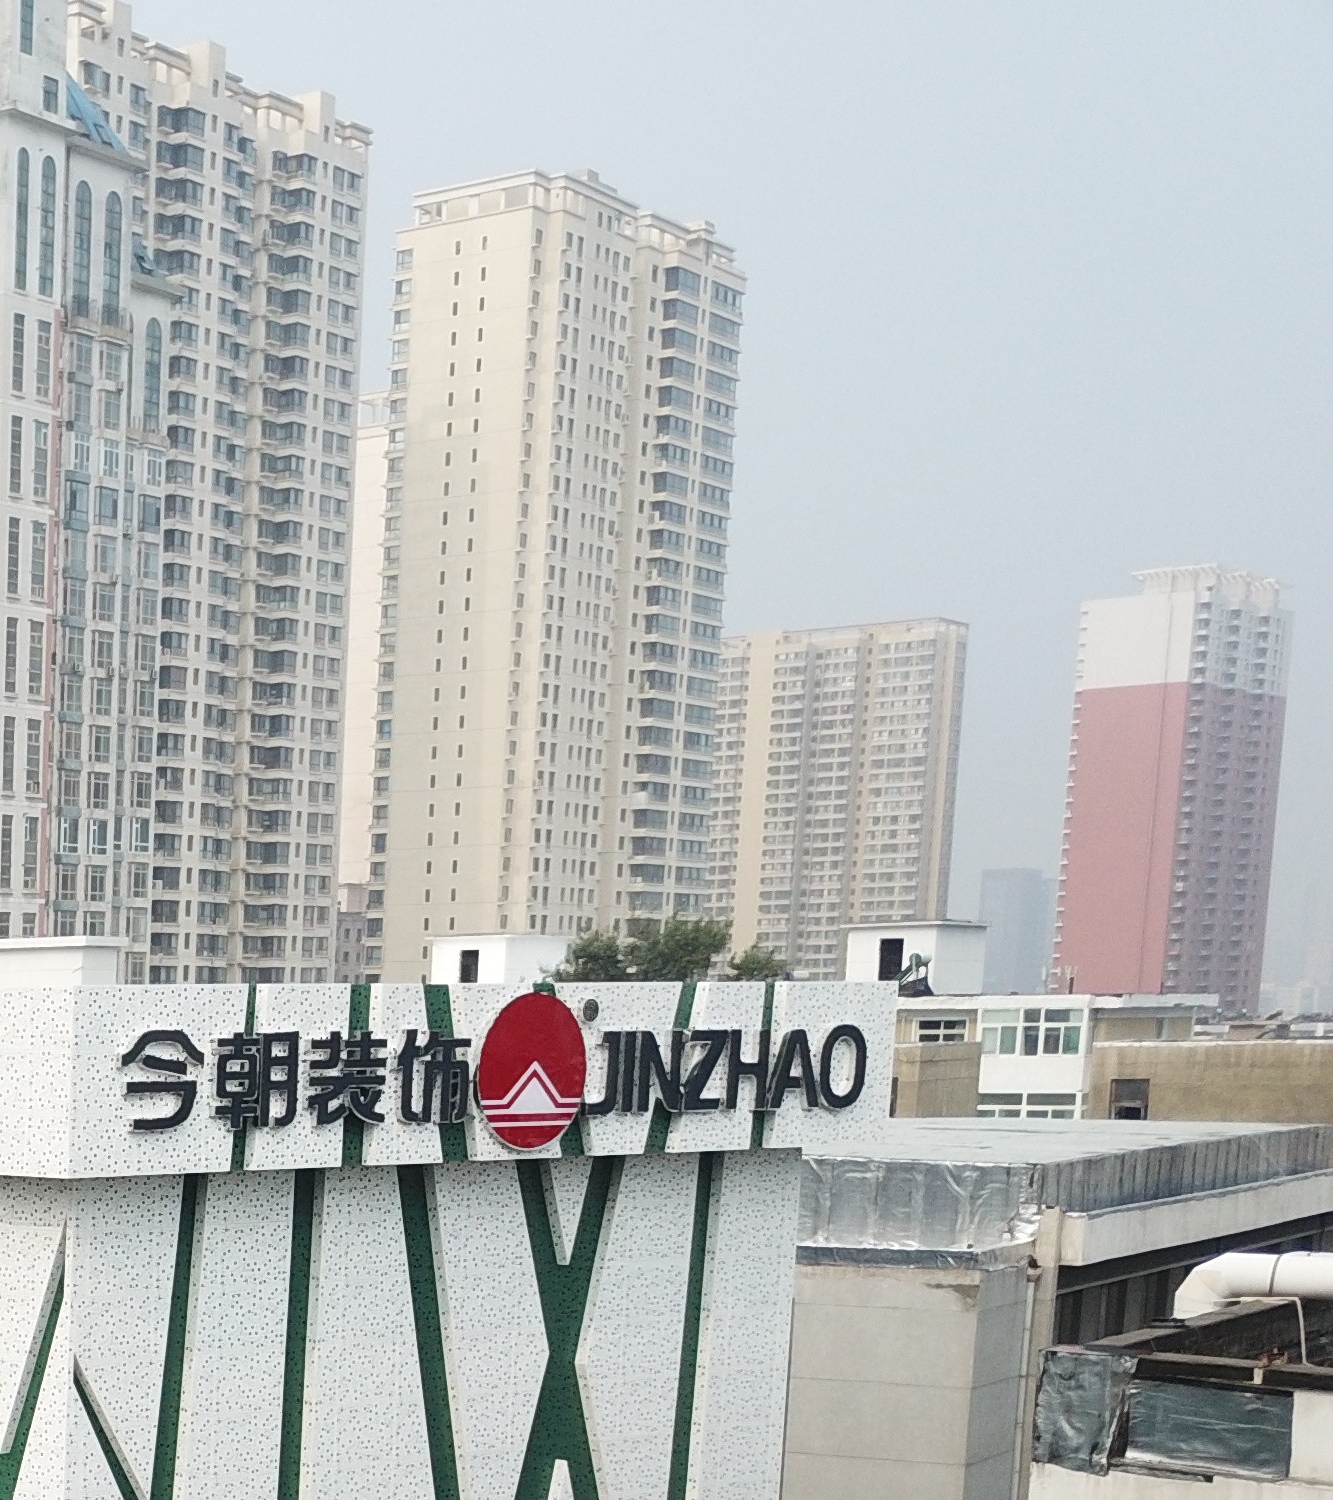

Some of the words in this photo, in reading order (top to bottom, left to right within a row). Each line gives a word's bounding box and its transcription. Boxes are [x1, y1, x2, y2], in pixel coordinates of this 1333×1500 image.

[120, 1028, 472, 1132] 今朝装饰
[585, 1023, 868, 1117] JINZHAO
